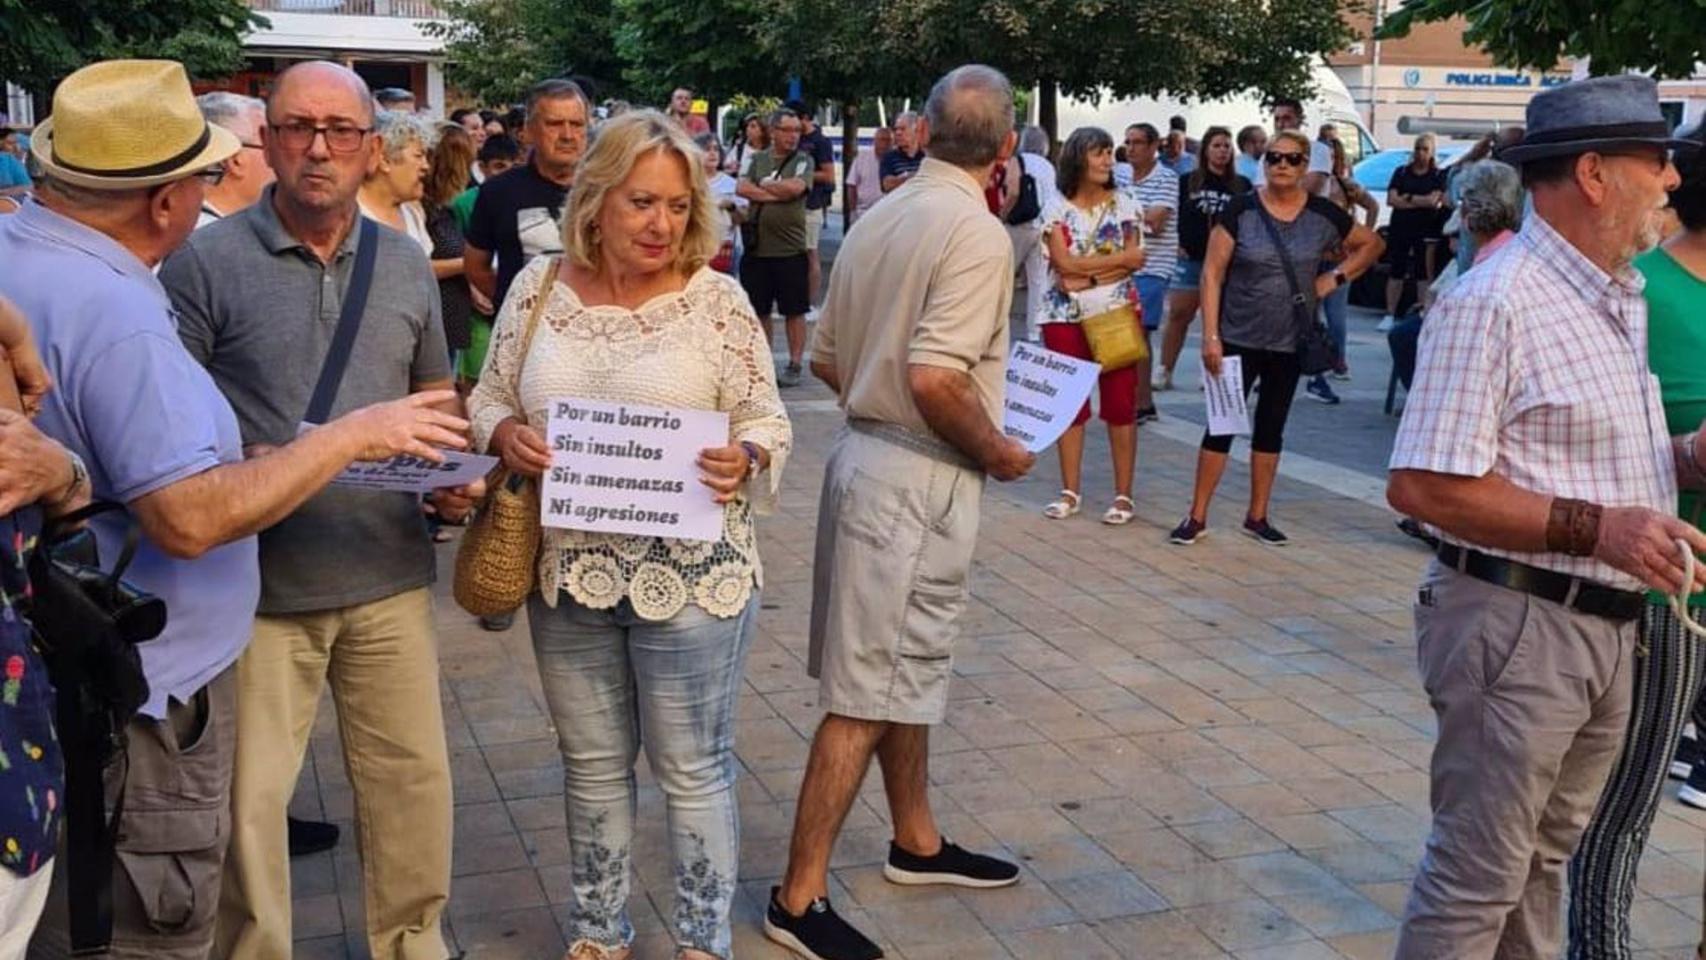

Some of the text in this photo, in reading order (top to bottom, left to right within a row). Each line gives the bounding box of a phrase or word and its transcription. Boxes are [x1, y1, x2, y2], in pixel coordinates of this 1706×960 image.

[555, 403, 681, 430] Por un barrio
[554, 434, 663, 460] Sin insultos
[550, 466, 684, 493] Sin amenazas
[548, 497, 680, 524] Ni agresiones
